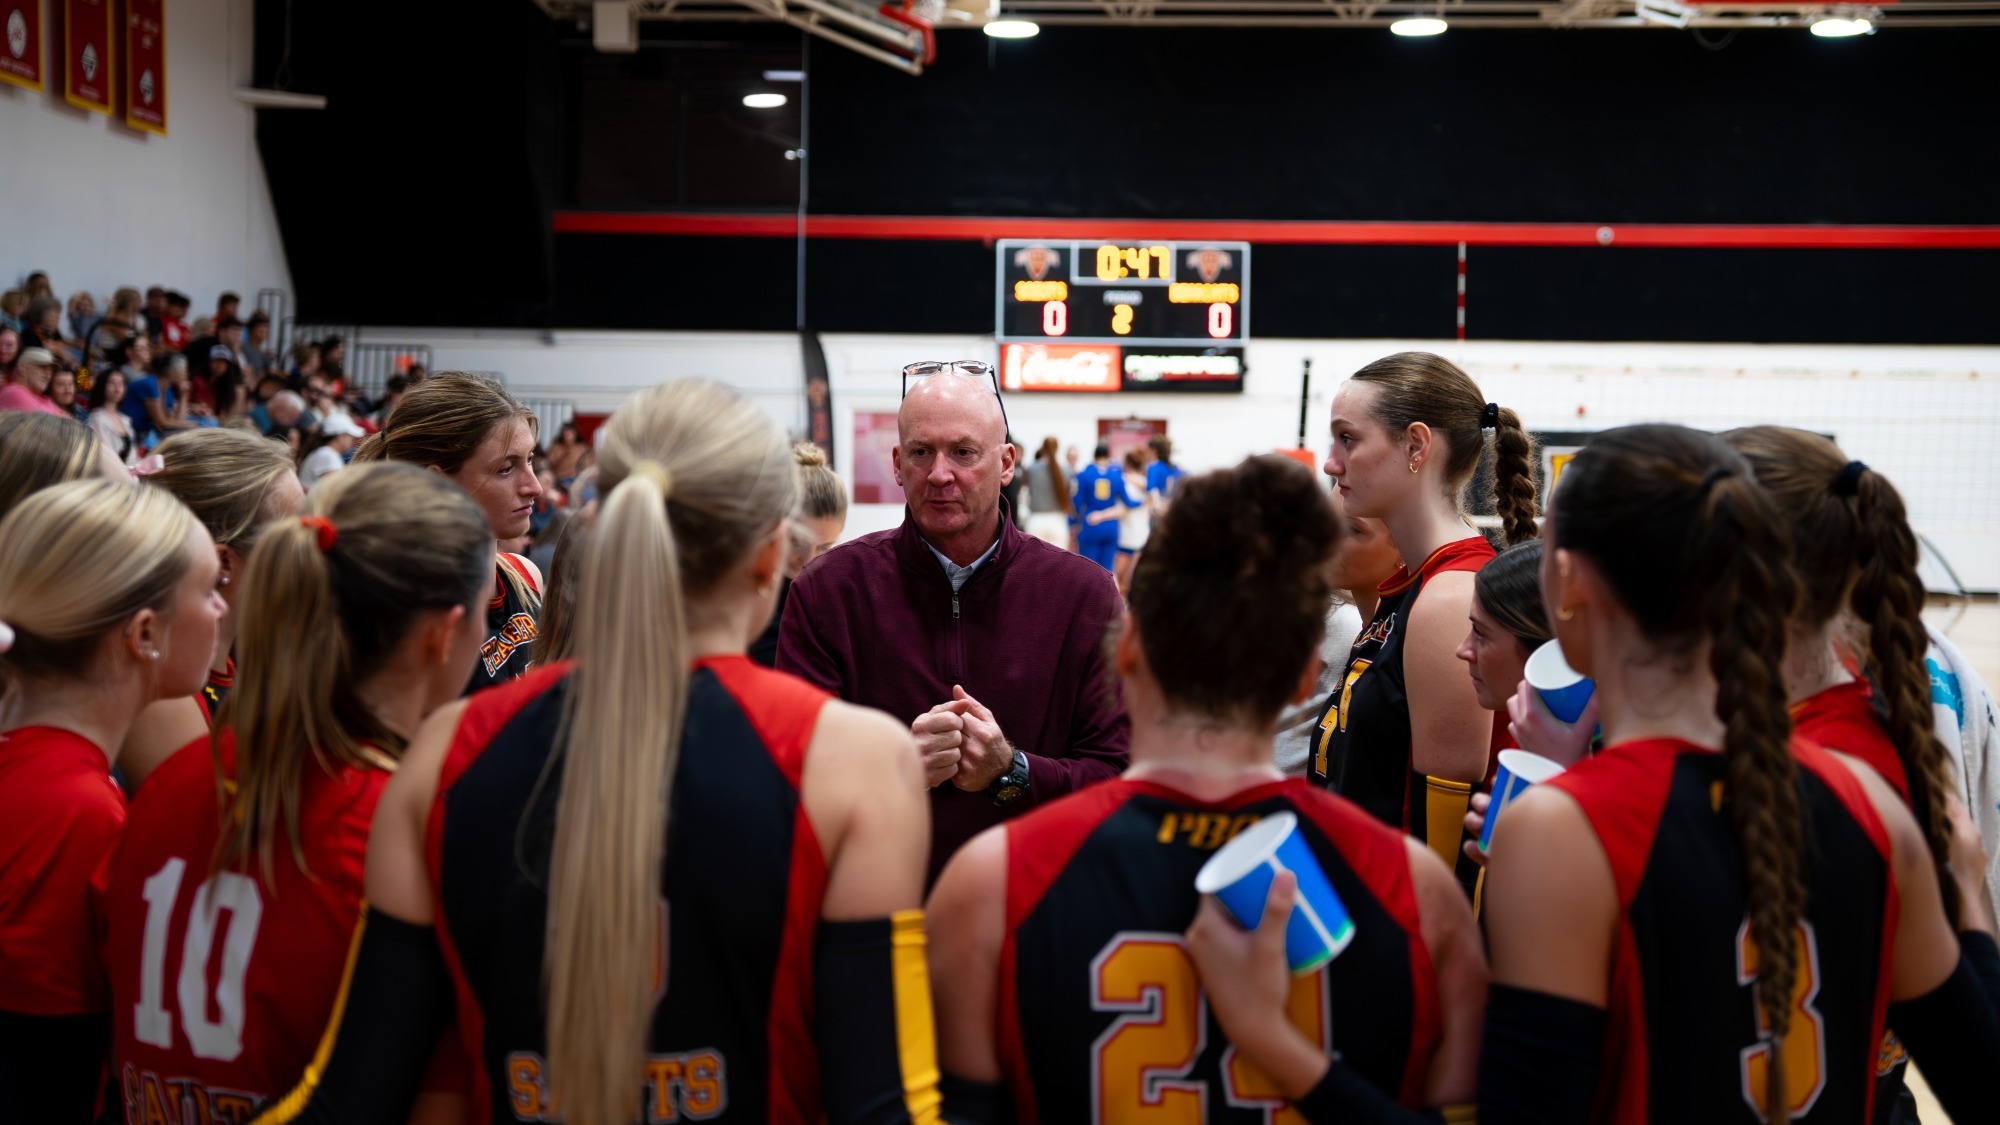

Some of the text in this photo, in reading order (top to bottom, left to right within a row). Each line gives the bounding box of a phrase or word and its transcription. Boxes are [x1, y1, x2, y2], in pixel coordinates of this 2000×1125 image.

[1097, 245, 1170, 281] 0:47
[1043, 300, 1067, 336] 0
[1112, 304, 1133, 334] 2
[1208, 302, 1232, 338] 0
[134, 856, 264, 1062] 10
[1735, 917, 1827, 1124] 3
[505, 1048, 728, 1122] STS
